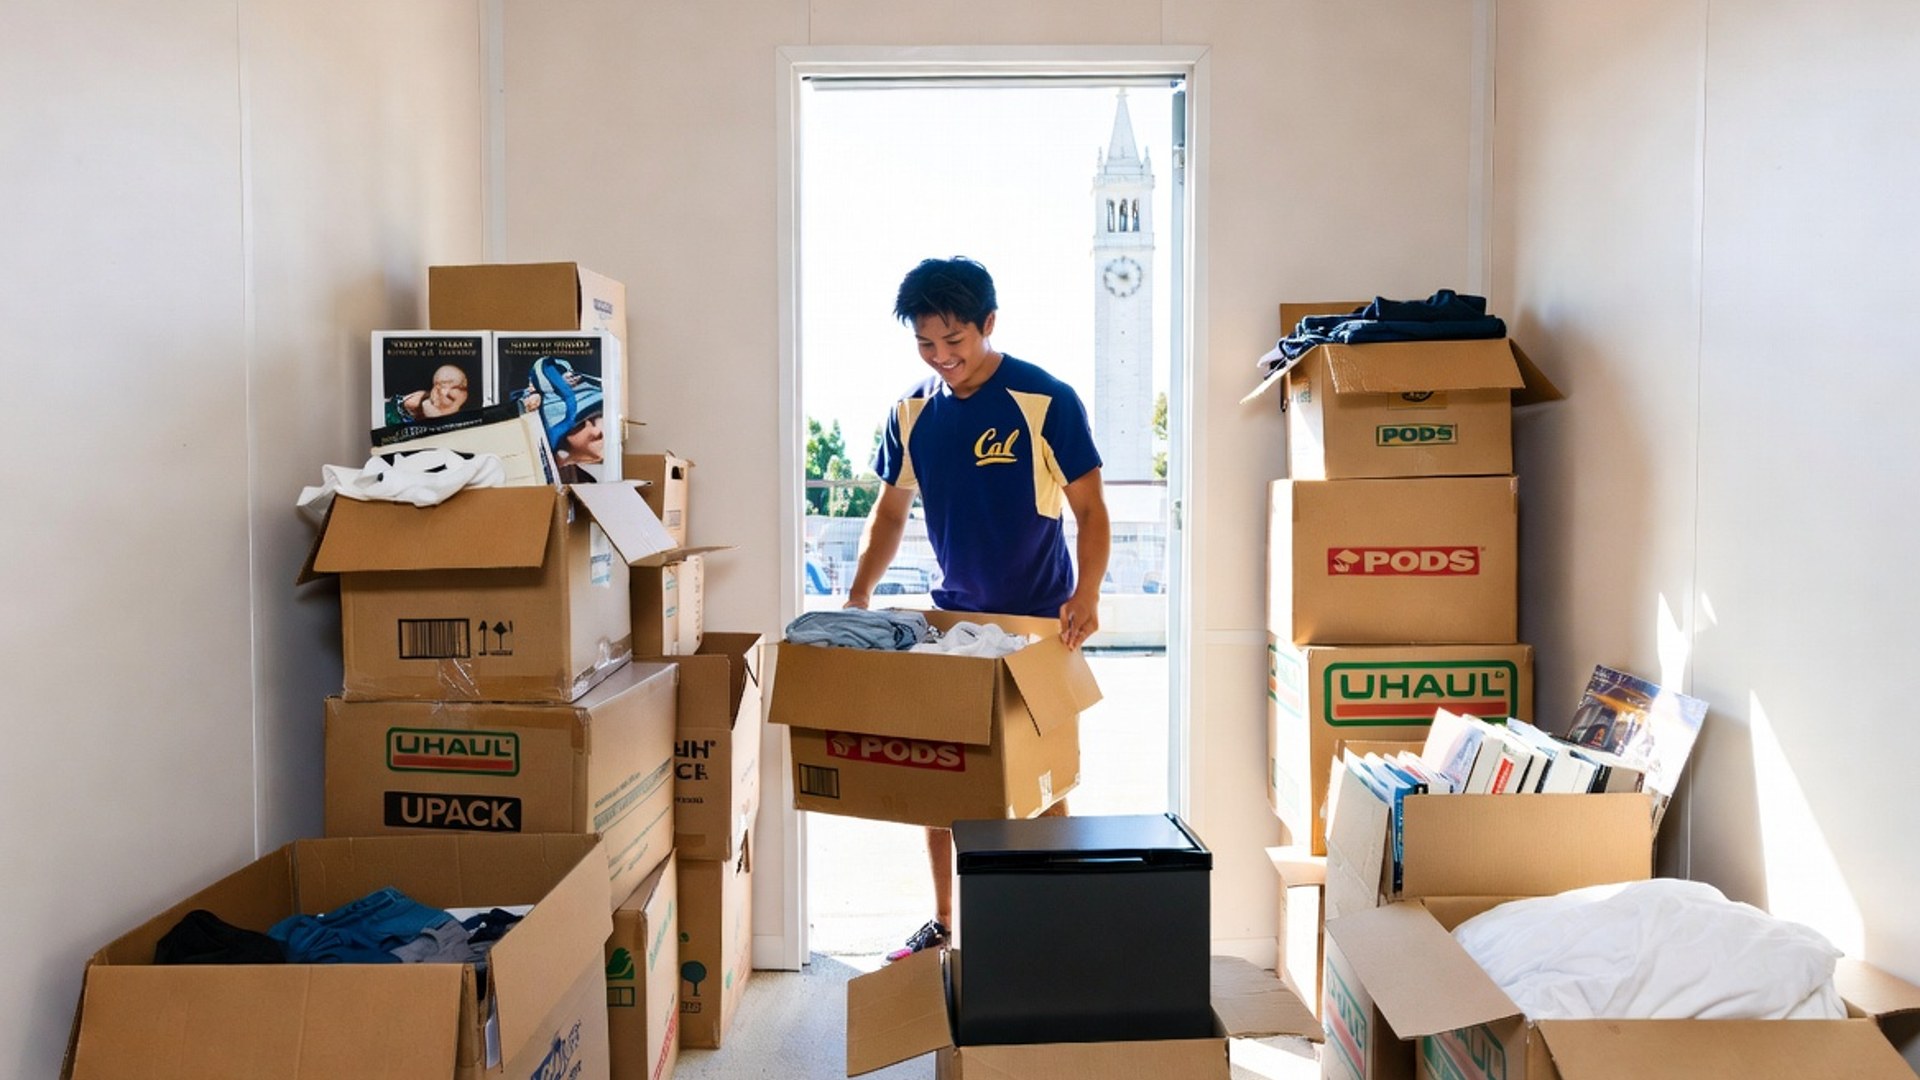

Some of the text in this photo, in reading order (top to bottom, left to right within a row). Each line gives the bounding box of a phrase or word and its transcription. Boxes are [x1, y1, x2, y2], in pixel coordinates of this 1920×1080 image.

[974, 428, 1020, 467] Cal
[1382, 427, 1453, 442] PODS
[1364, 550, 1475, 573] PODS
[1340, 673, 1504, 699] UHAUL
[396, 735, 511, 757] UHAUL
[860, 735, 961, 768] PODS
[401, 797, 514, 839] UPACK
